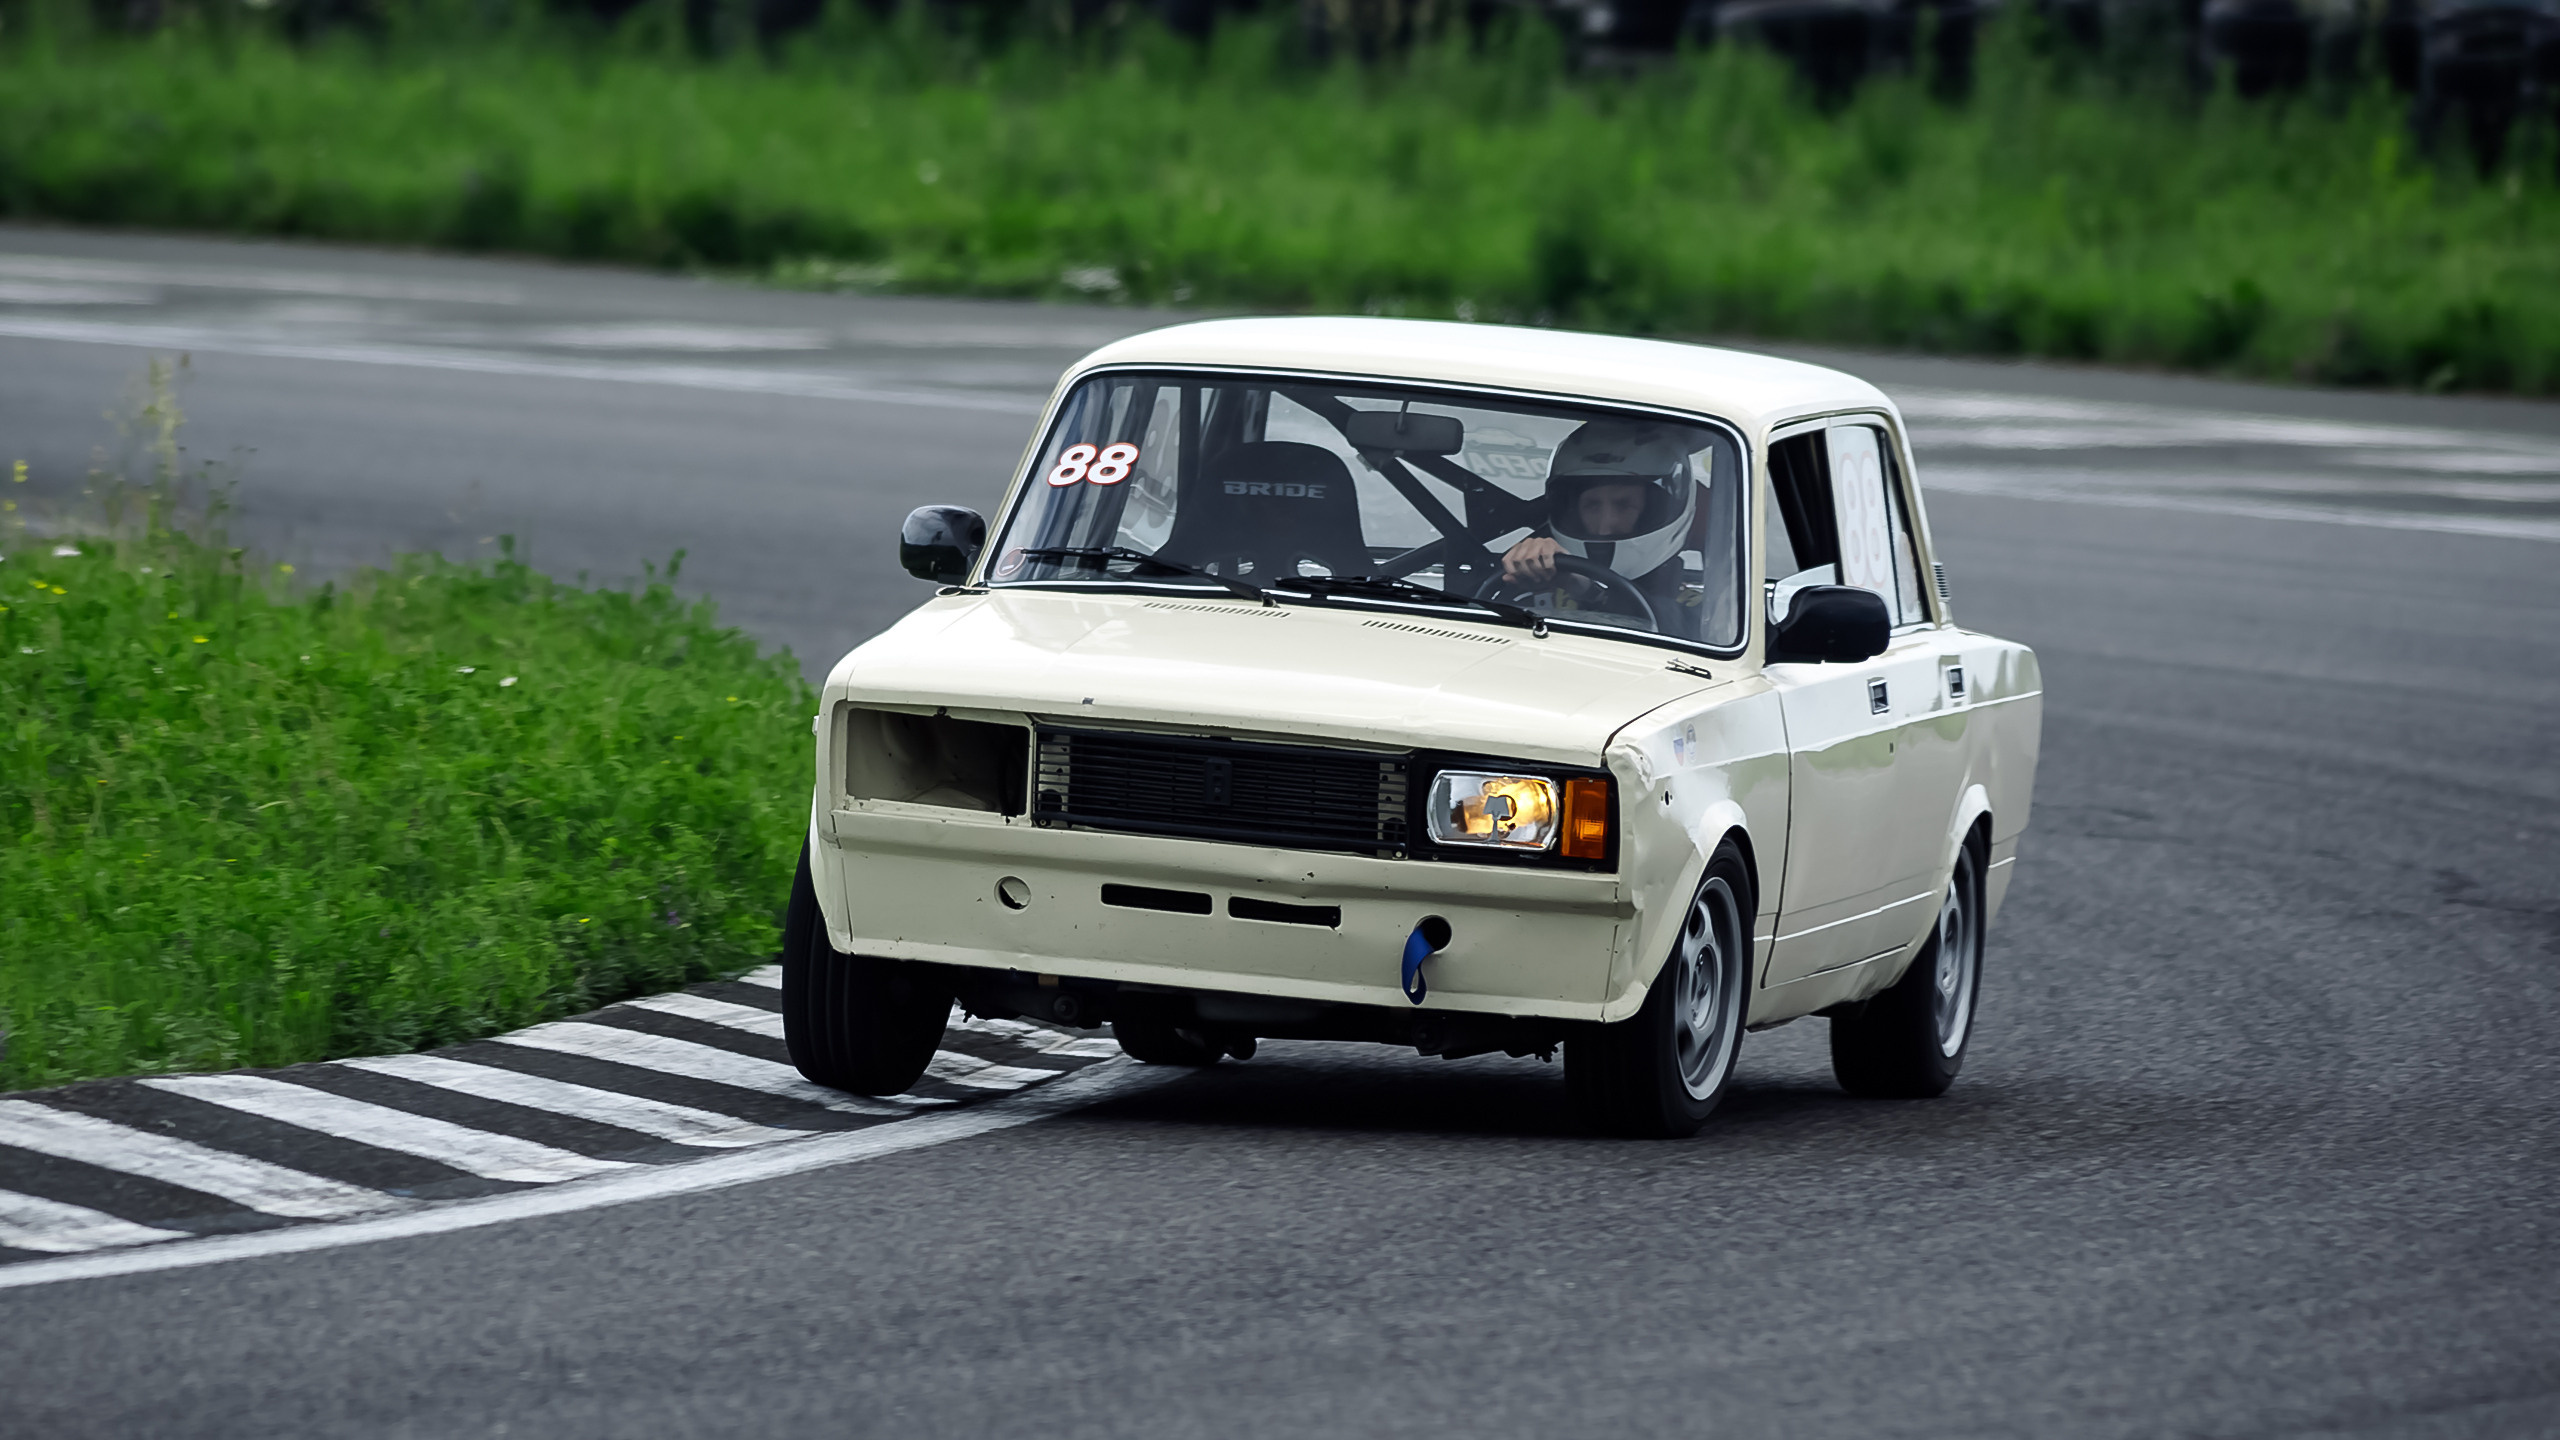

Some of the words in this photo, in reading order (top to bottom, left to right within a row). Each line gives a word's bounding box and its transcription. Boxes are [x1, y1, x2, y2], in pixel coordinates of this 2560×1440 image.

[1047, 443, 1140, 487] 88
[1223, 481, 1328, 499] BRIDE
[1840, 451, 1887, 588] 88
